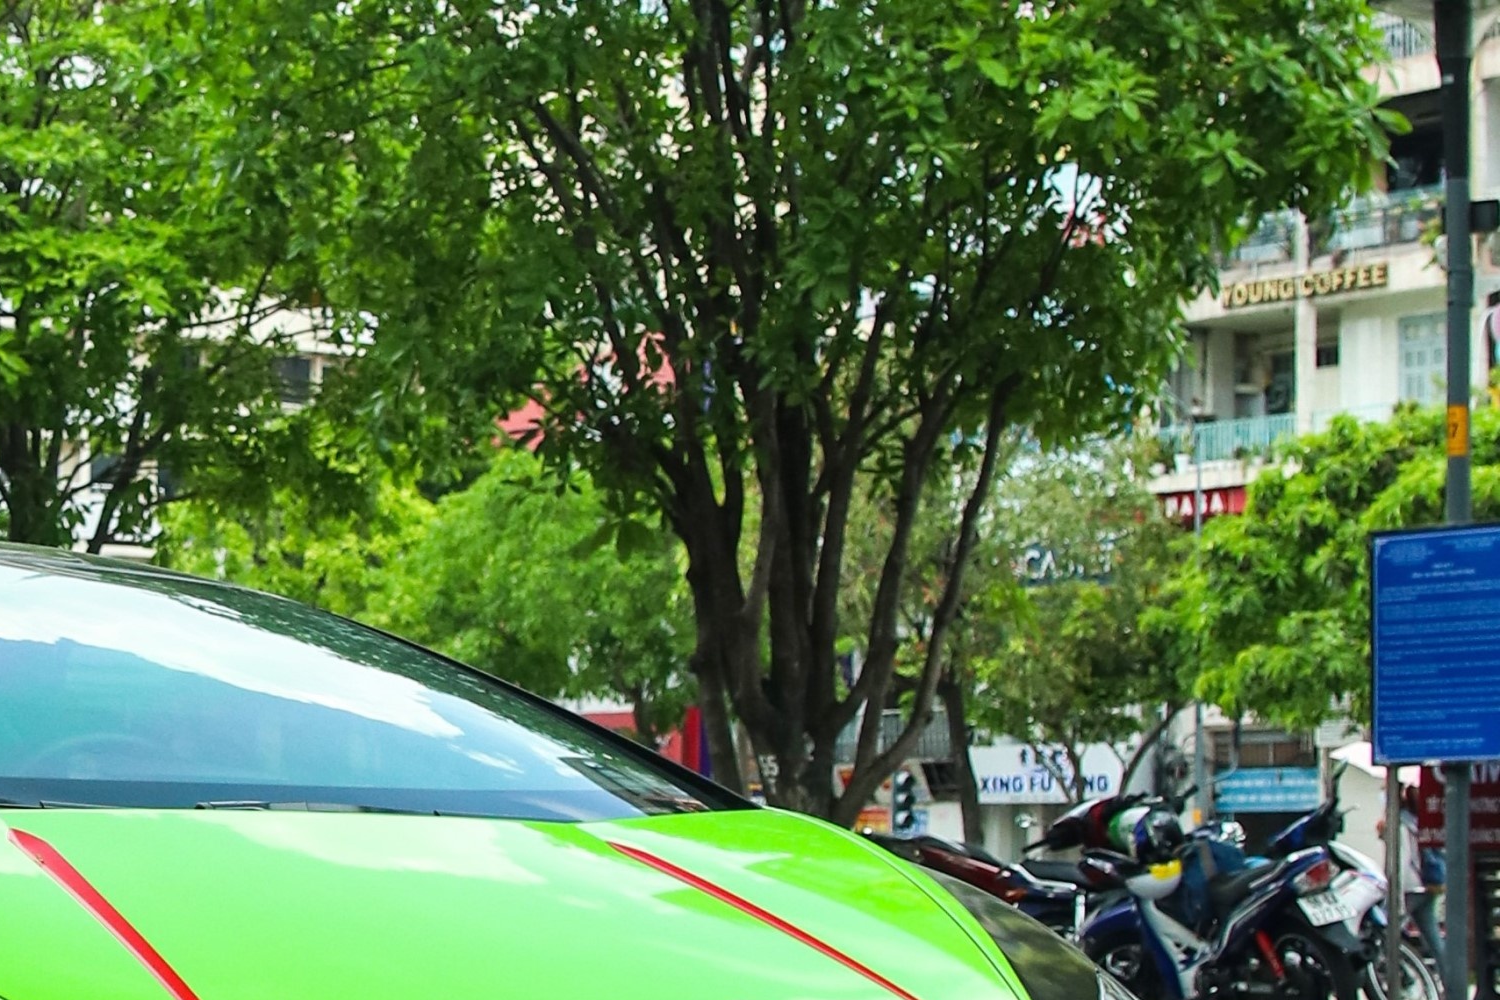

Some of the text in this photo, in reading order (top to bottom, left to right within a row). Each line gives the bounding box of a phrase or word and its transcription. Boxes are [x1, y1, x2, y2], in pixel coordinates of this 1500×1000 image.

[1222, 263, 1388, 307] YOUNG COFFEE
[981, 775, 1023, 792] XING
[1030, 775, 1052, 792] FU
